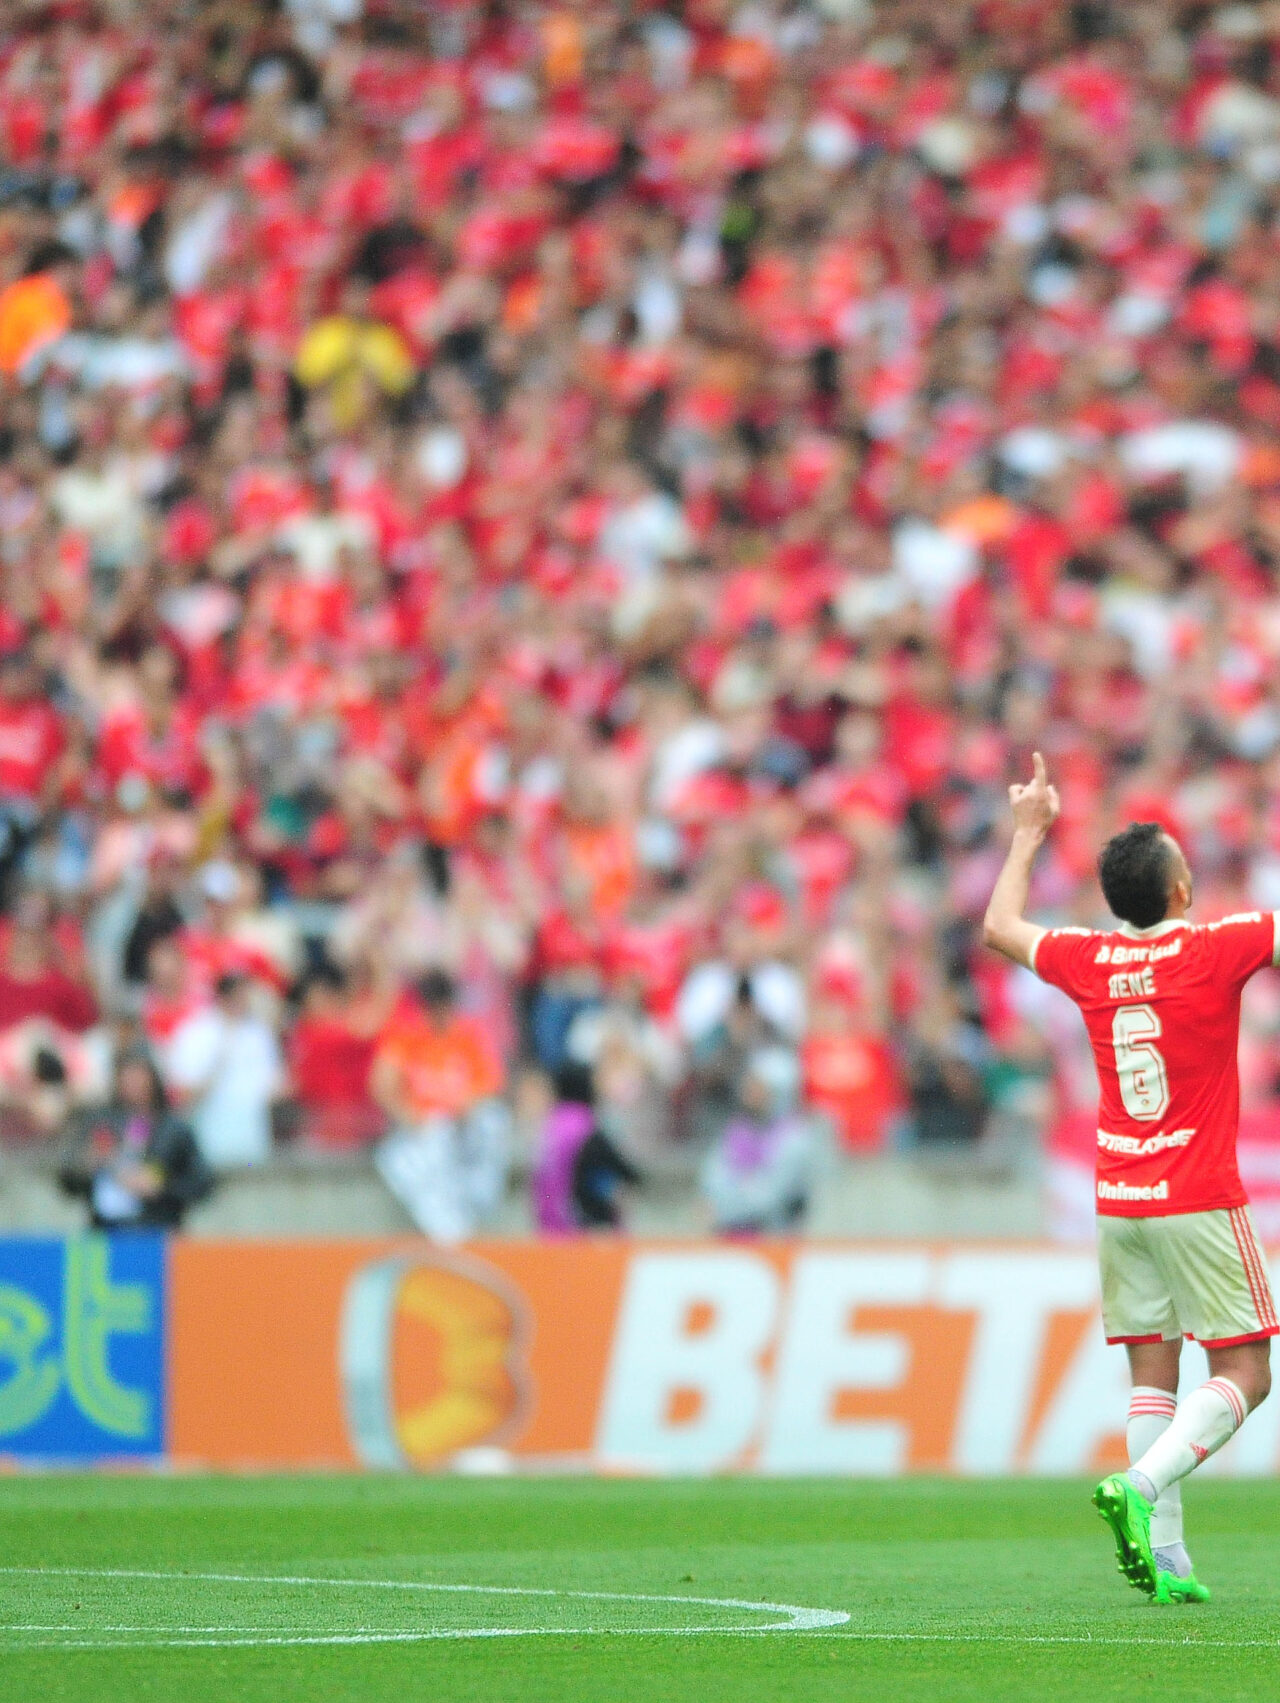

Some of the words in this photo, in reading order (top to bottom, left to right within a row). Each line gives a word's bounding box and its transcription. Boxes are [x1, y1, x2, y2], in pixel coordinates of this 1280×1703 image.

[1110, 938, 1181, 964] Bnrisul
[1108, 966, 1157, 999] RENÉ
[1112, 1003, 1171, 1121] 6
[1097, 1180, 1169, 1201] Unimed
